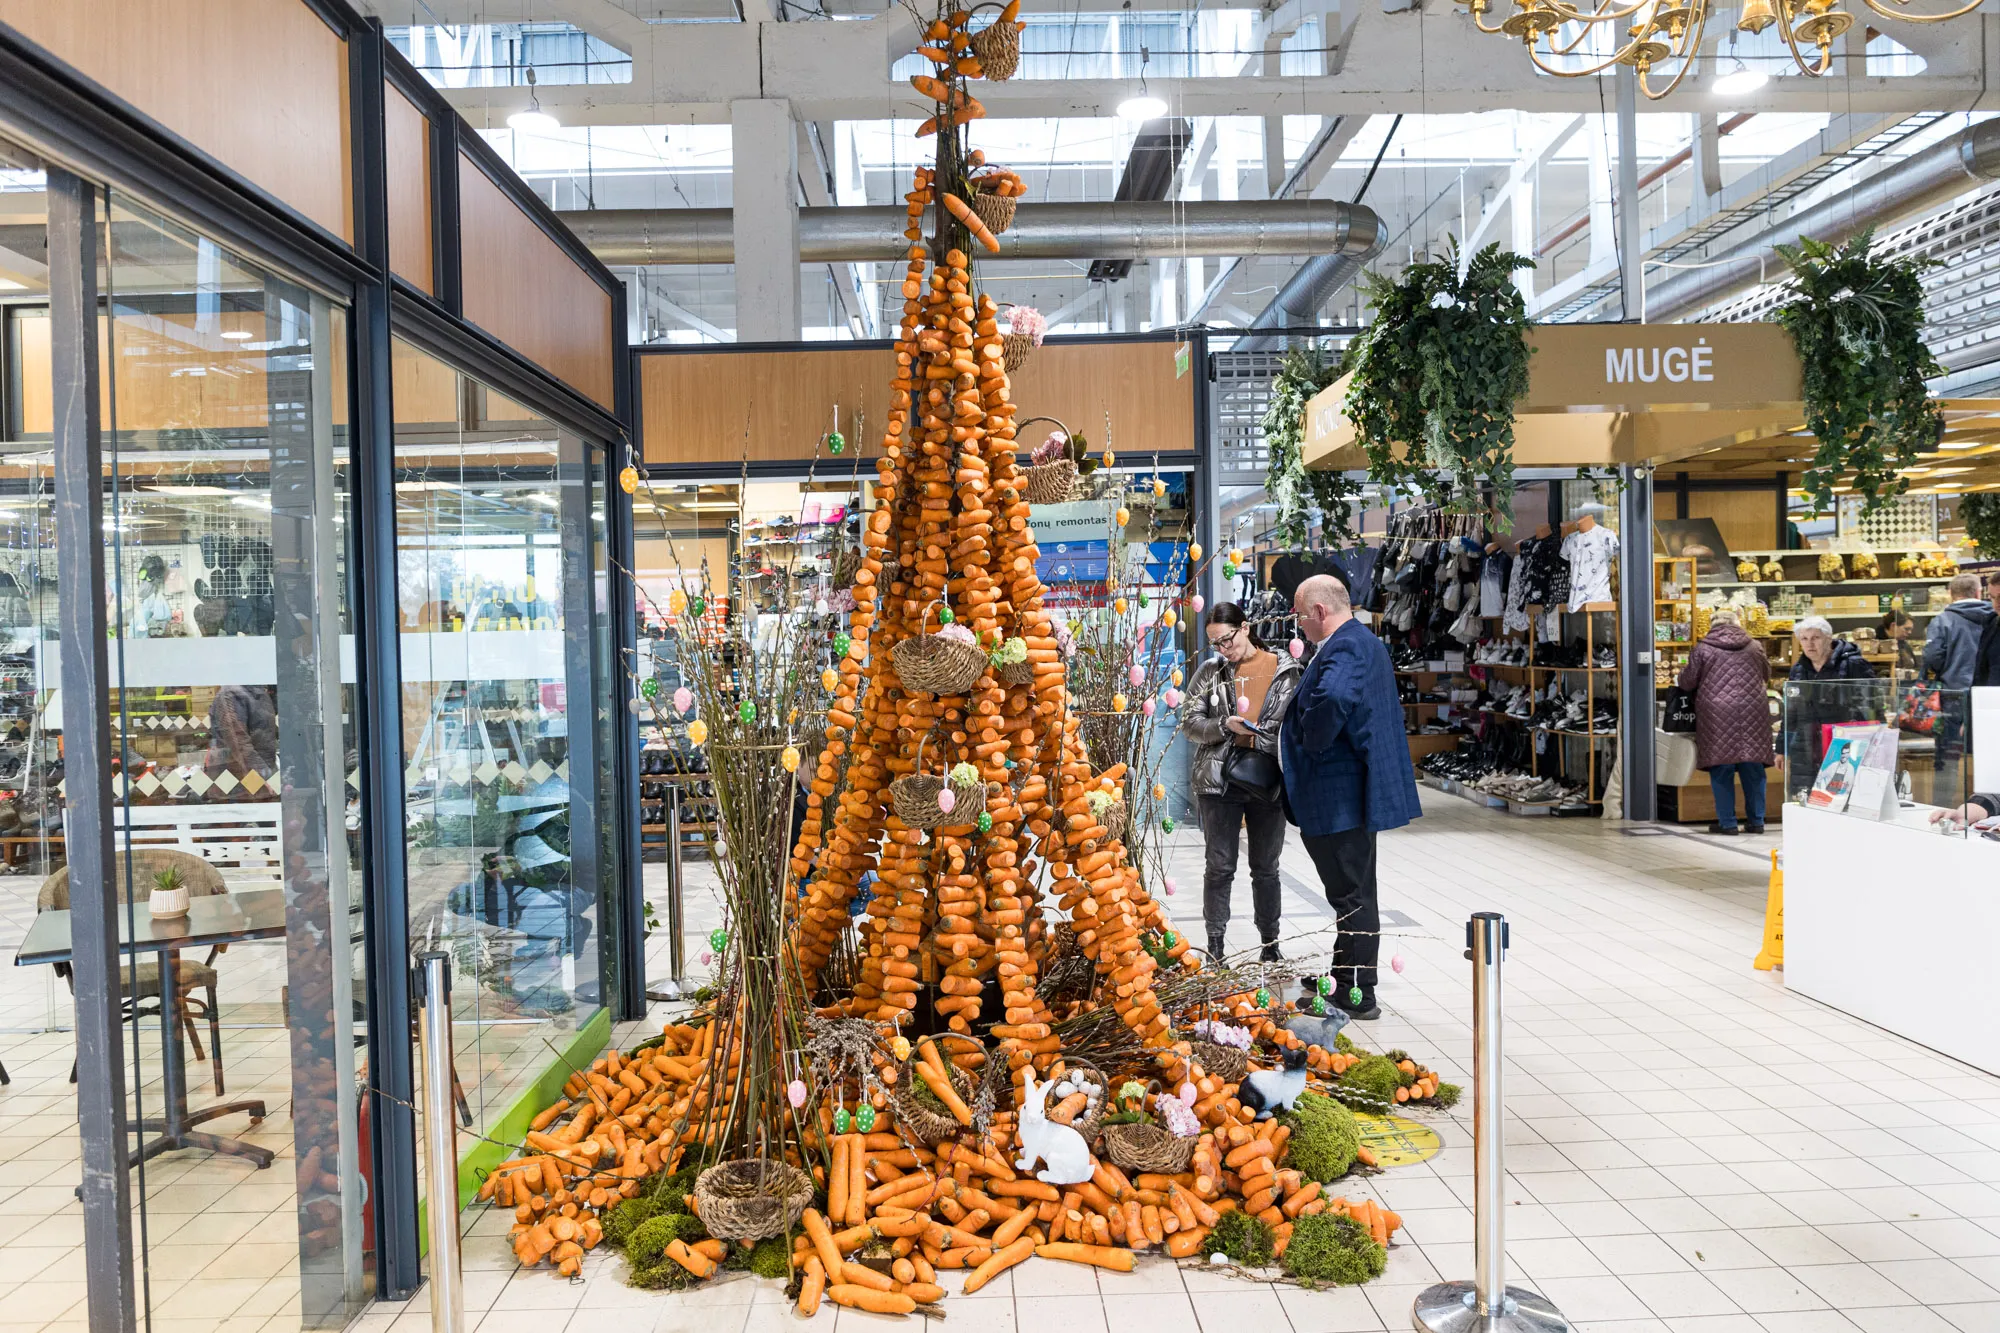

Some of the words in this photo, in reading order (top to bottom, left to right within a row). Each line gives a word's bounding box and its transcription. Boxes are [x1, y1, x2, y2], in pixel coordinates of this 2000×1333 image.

[1605, 337, 1715, 383] MUGĖ
[1056, 517, 1107, 527] remontas
[1680, 696, 1688, 708] I
[1672, 710, 1696, 723] shop
